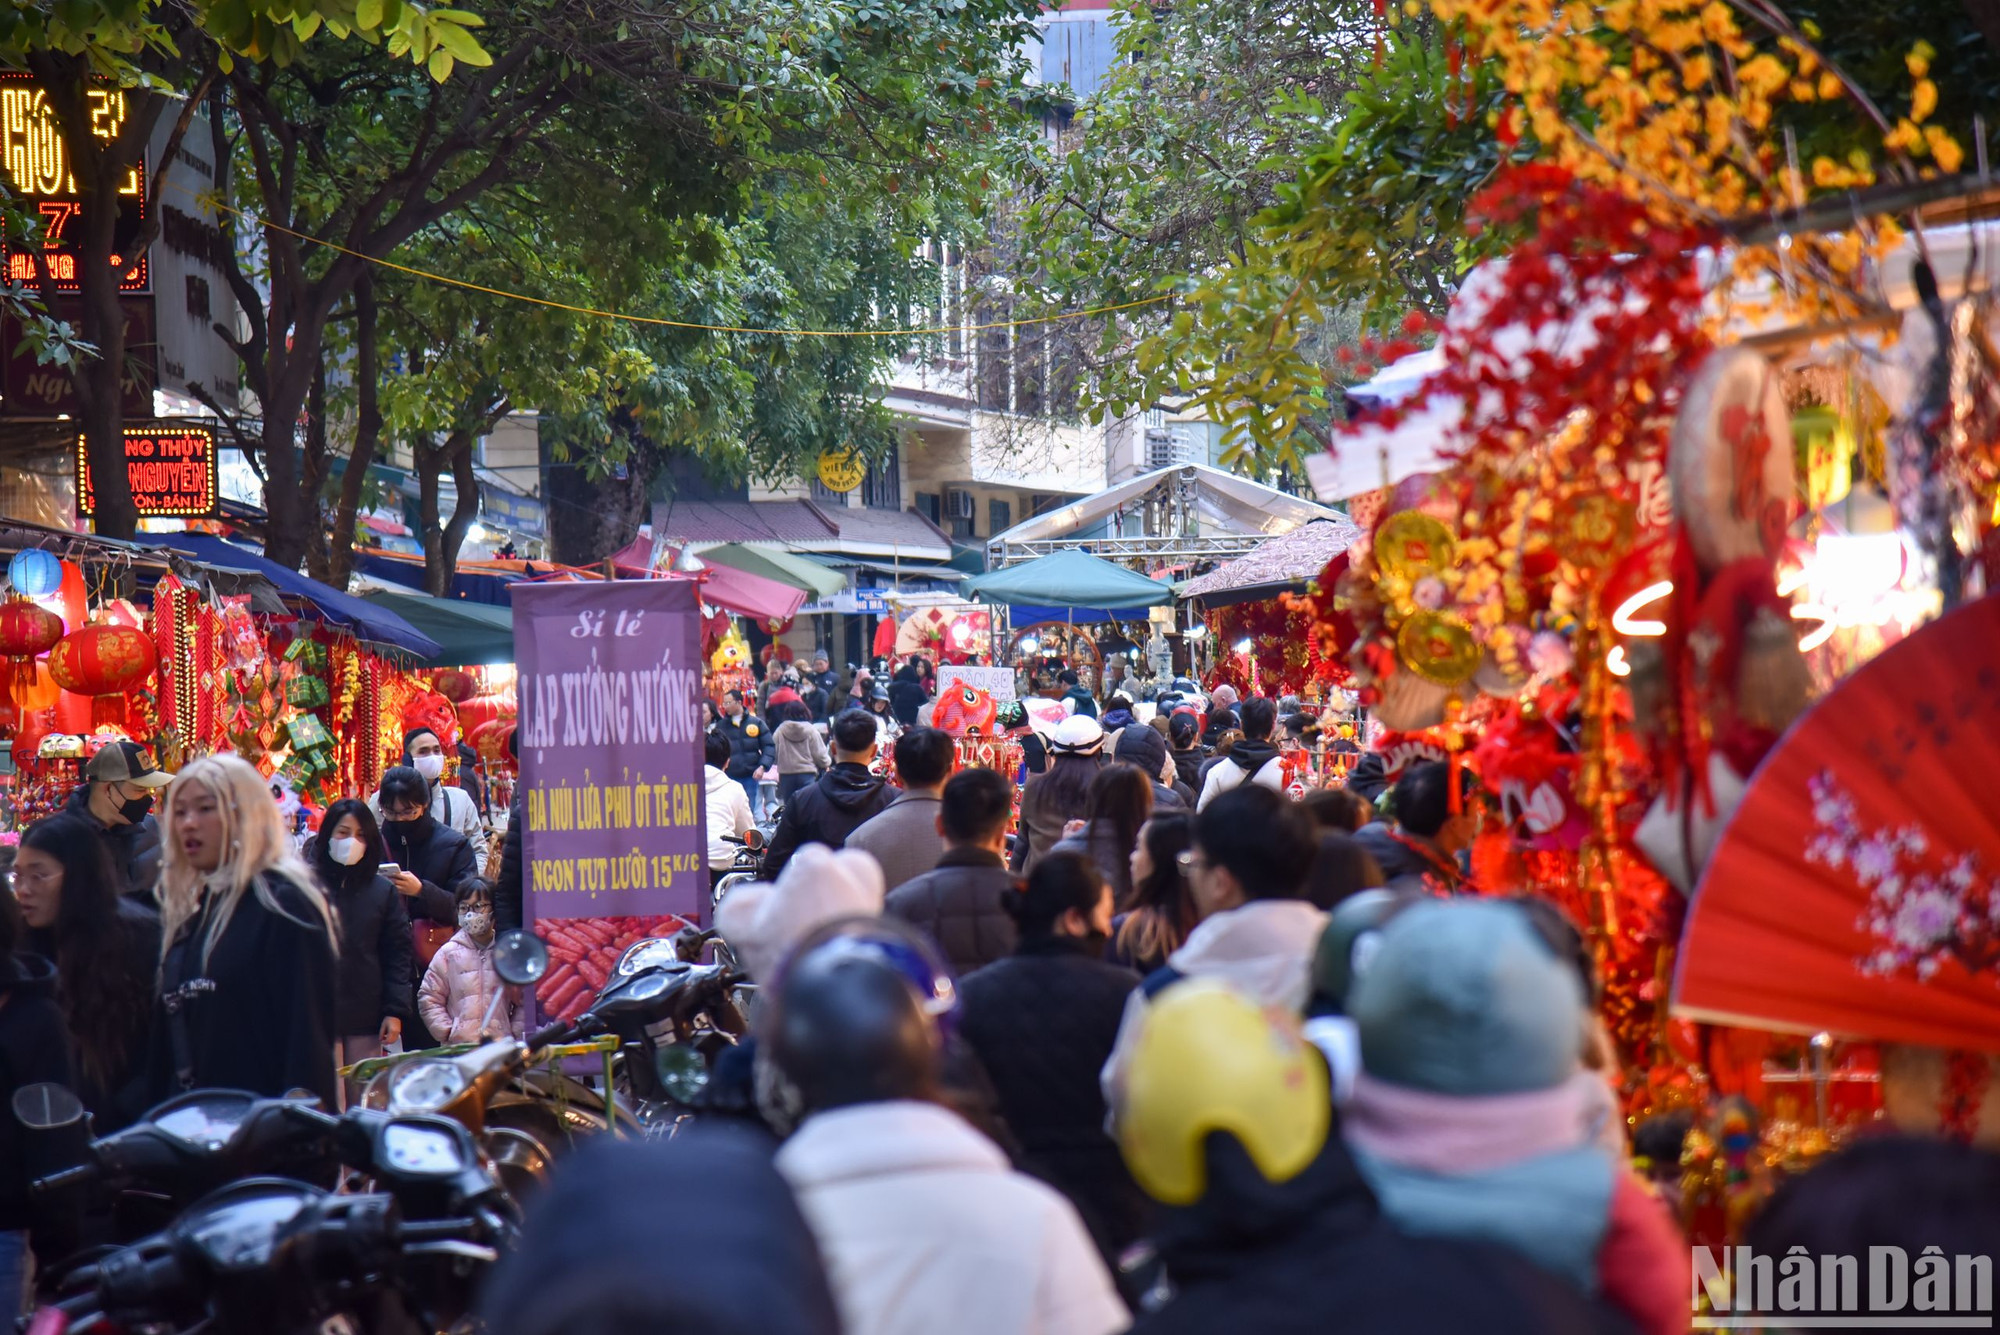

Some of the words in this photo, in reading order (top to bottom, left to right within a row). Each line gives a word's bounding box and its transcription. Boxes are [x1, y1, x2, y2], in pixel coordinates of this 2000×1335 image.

[520, 673, 559, 765] LẠP
[561, 646, 629, 746] XƯỞNG
[631, 647, 699, 745] NƯỚNG
[528, 779, 547, 832] ĐÁ
[549, 777, 574, 832] NÚI
[576, 767, 602, 831] LỬA
[604, 766, 632, 829] PHỦ
[634, 771, 651, 828] ỚT
[653, 774, 670, 827] TÊ
[672, 783, 699, 826] CAY
[531, 858, 574, 892] NGON
[577, 857, 608, 899] TỤT
[610, 846, 648, 890] LƯỠI
